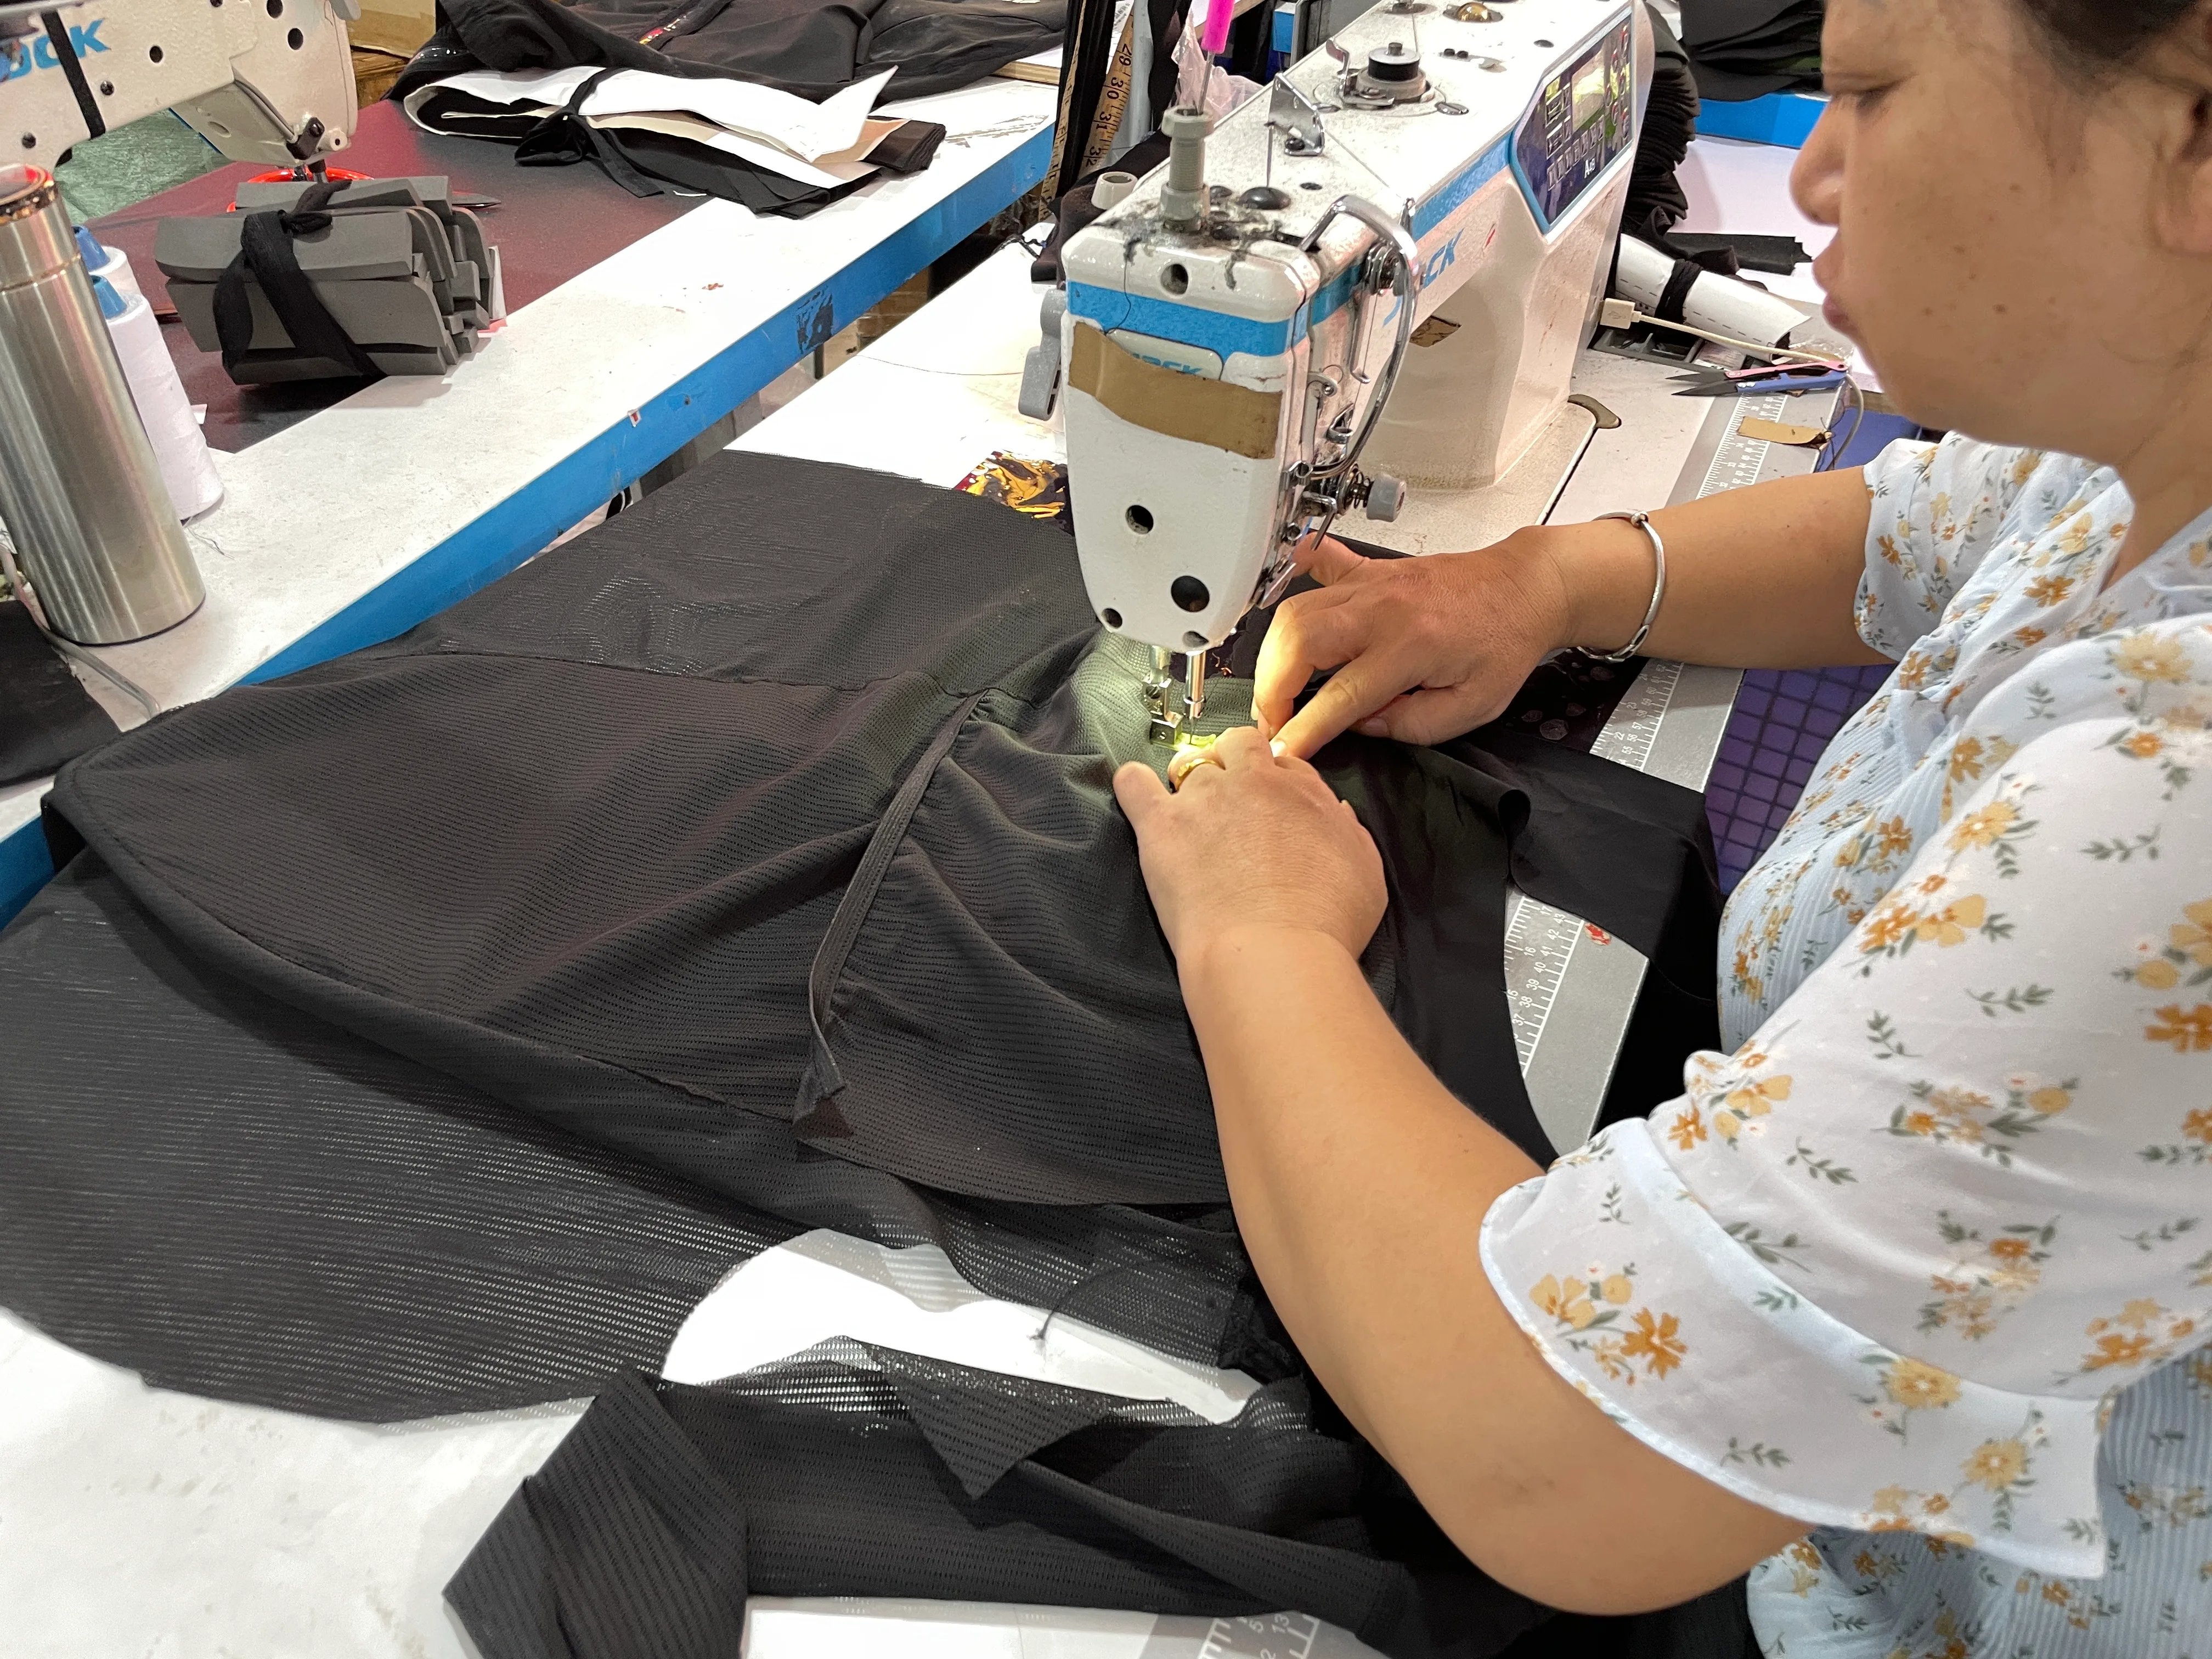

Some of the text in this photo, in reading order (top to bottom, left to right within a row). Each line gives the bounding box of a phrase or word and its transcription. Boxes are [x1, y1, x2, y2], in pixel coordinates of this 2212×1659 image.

[1107, 77, 1124, 99] 30
[1096, 112, 1111, 130] 31
[1086, 146, 1102, 167] 32
[1646, 686, 1657, 695] 60
[1641, 698, 1652, 707] 59
[1637, 709, 1647, 718] 58
[1632, 721, 1643, 730] 57
[1613, 731, 1625, 741] 22
[1627, 733, 1638, 742] 56
[1622, 746, 1633, 754] 55
[1553, 913, 1566, 924] 43
[1523, 946, 1536, 957] 16
[1540, 905, 1553, 915] 17
[1547, 928, 1560, 940] 42
[1540, 945, 1553, 957] 41
[1533, 961, 1547, 974] 40
[1526, 978, 1539, 991] 39
[1519, 996, 1533, 1008] 38
[1511, 1013, 1525, 1026] 37
[1271, 1613, 1290, 1634] 13
